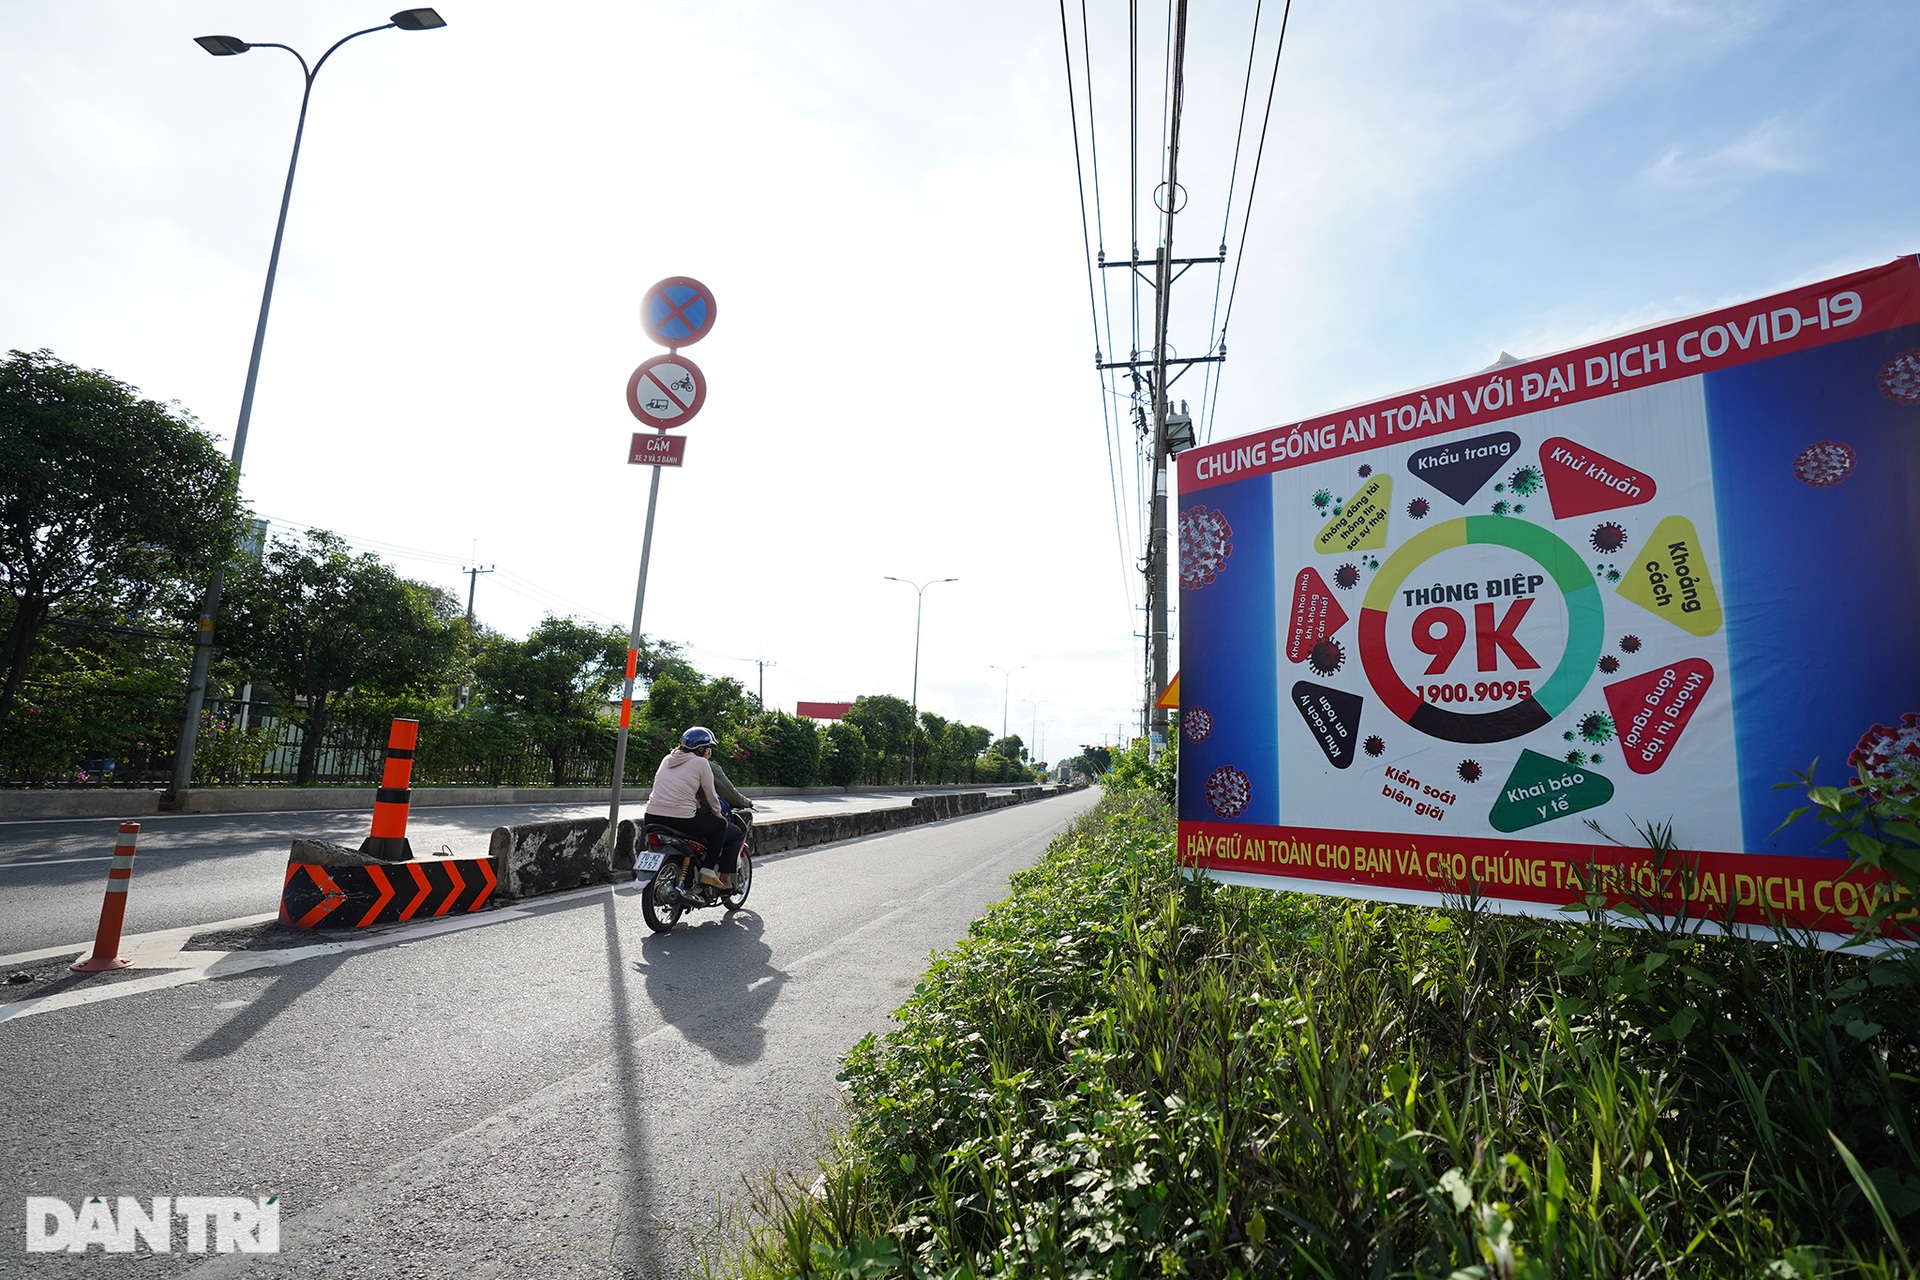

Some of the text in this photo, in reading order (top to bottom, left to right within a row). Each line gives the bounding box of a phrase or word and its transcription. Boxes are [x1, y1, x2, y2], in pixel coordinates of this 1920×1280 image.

[1196, 291, 1862, 480] CHUNG SỐNG AN TOÀN VỚI ĐẠI DỊCH COVID-19
[646, 437, 670, 452] CẤM
[648, 454, 656, 462] VÀ
[661, 455, 678, 463] BÁNH
[1417, 442, 1511, 470] Khẩu trang
[1550, 446, 1642, 498] Khử khuẩn
[1320, 482, 1380, 544] Không đăng tải
[1340, 504, 1376, 540] thông tin
[1347, 508, 1388, 551] sai sự thật
[1403, 573, 1544, 607] THÔNG ĐIỆP
[1645, 560, 1673, 607] cách
[1668, 541, 1702, 613] Khoảng
[1291, 628, 1303, 658] Không
[1297, 616, 1304, 626] ra
[1305, 594, 1319, 639] khi không
[1411, 598, 1541, 675] 9K
[1416, 680, 1532, 703] 1900.9095
[1623, 668, 1677, 749] đông người
[1300, 694, 1342, 758] Khu cách ly
[1319, 695, 1348, 738] an toàn
[1641, 671, 1704, 762] Không tụ tập
[1381, 784, 1445, 822] biên giới
[1384, 765, 1457, 806] Kiểm soát
[1506, 772, 1586, 803] Khai báo
[1536, 793, 1570, 819] y tế
[1187, 831, 1214, 857] HÃY
[1216, 832, 1242, 860] GIỮ
[1243, 838, 1266, 861] AN
[1268, 836, 1312, 866] TOÀN
[1315, 842, 1350, 870] CHO
[1354, 847, 1391, 878] BẠN
[1395, 844, 1422, 876] VÀ
[1426, 852, 1467, 880] CHO
[1471, 851, 1546, 887] CHÚNG
[1551, 861, 1583, 891] TA
[1679, 868, 1727, 911] ĐẠI
[1734, 874, 1806, 915] DỊCH
